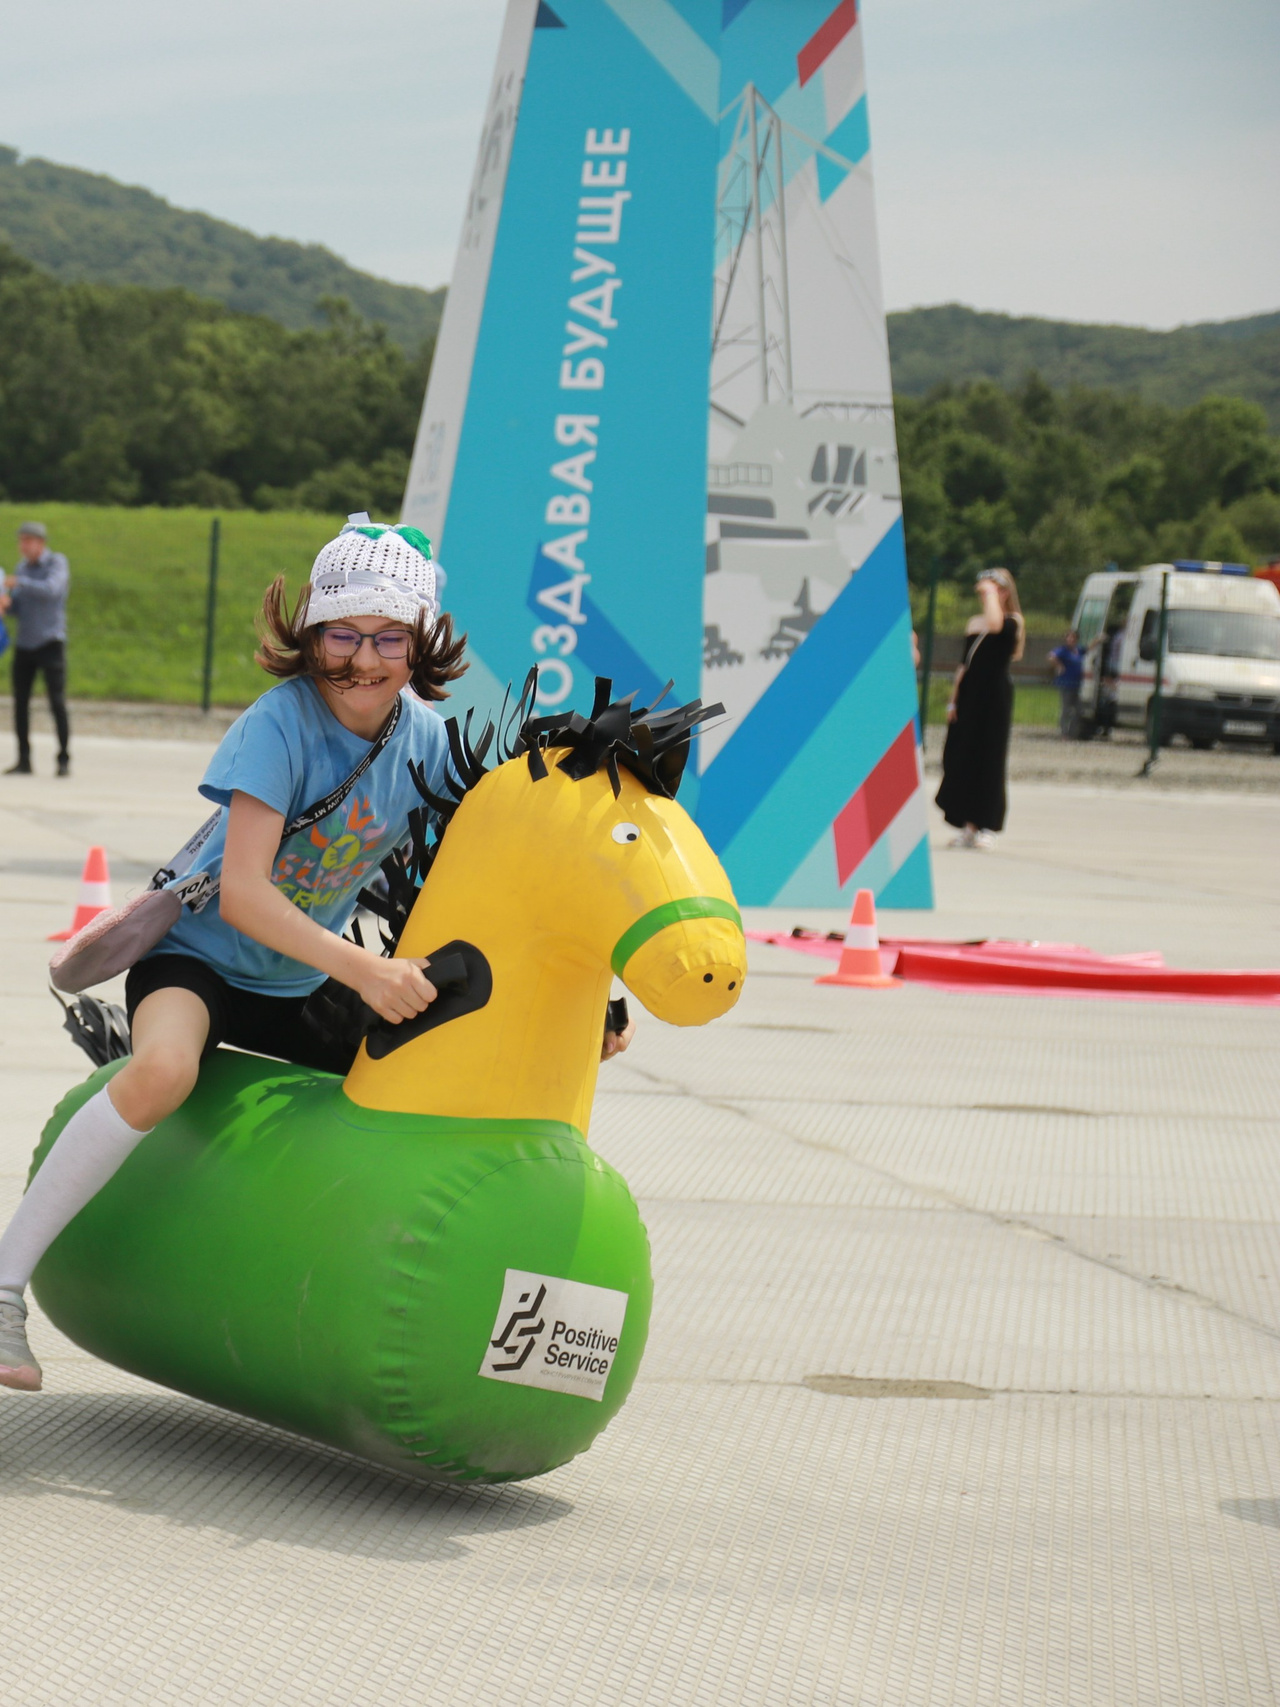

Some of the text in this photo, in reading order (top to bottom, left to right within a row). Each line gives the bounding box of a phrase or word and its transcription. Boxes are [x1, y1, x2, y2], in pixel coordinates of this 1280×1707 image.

[531, 128, 631, 720] ОЗДАВАЯ БУДУЩЕЕ
[551, 1320, 618, 1353] Positive
[544, 1343, 608, 1375] Service
